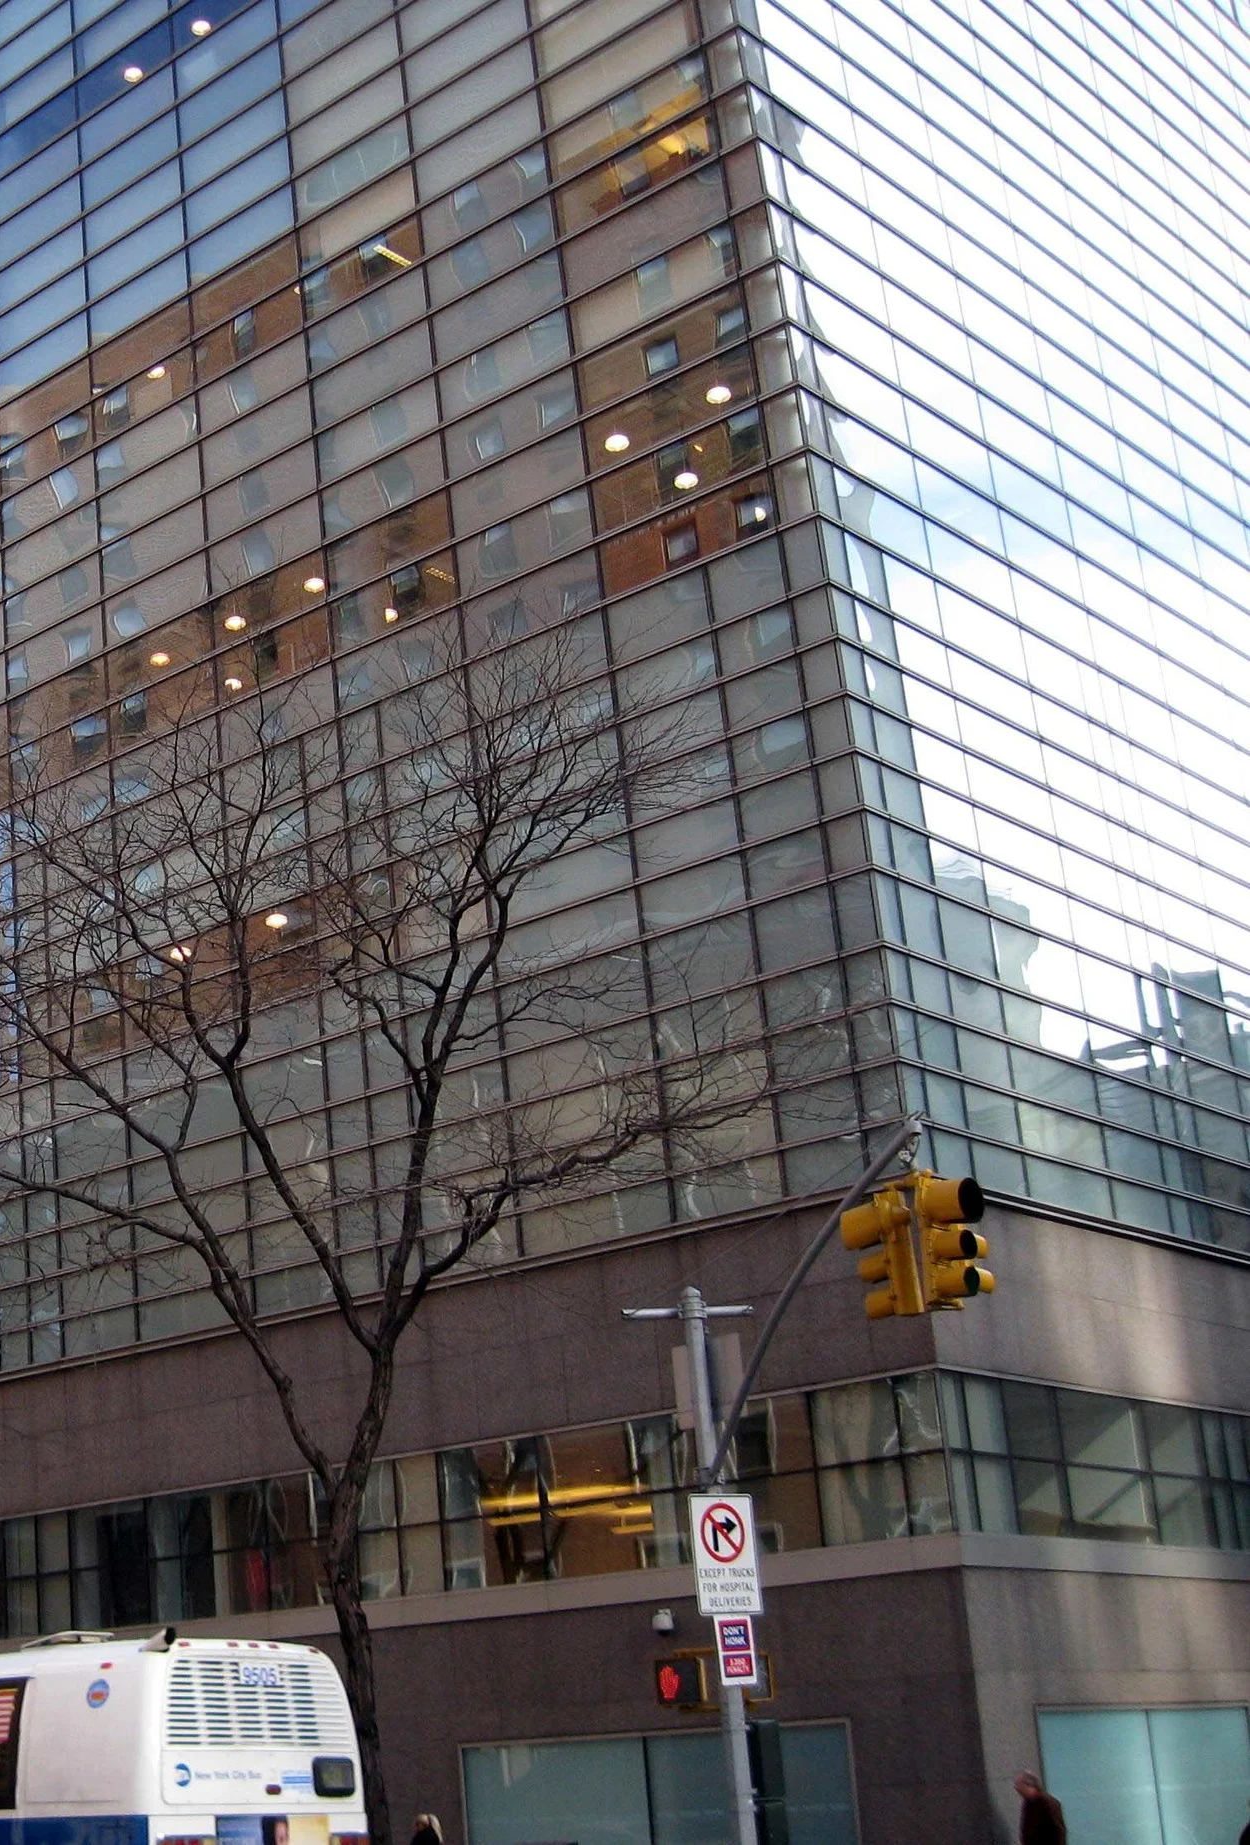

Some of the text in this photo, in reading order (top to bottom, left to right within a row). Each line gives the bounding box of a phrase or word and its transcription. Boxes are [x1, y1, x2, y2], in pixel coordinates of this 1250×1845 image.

[699, 1567, 755, 1579] EXCEPT TRUCKS
[702, 1581, 755, 1592] FOR HOSPITAL
[709, 1596, 752, 1607] DELIVERIES
[722, 1625, 745, 1636] DON'T
[724, 1636, 747, 1646] HONK
[243, 1666, 277, 1685] 9505
[194, 1771, 211, 1780] New
[213, 1770, 230, 1780] York
[231, 1770, 247, 1782] City
[248, 1770, 262, 1780] Bus
